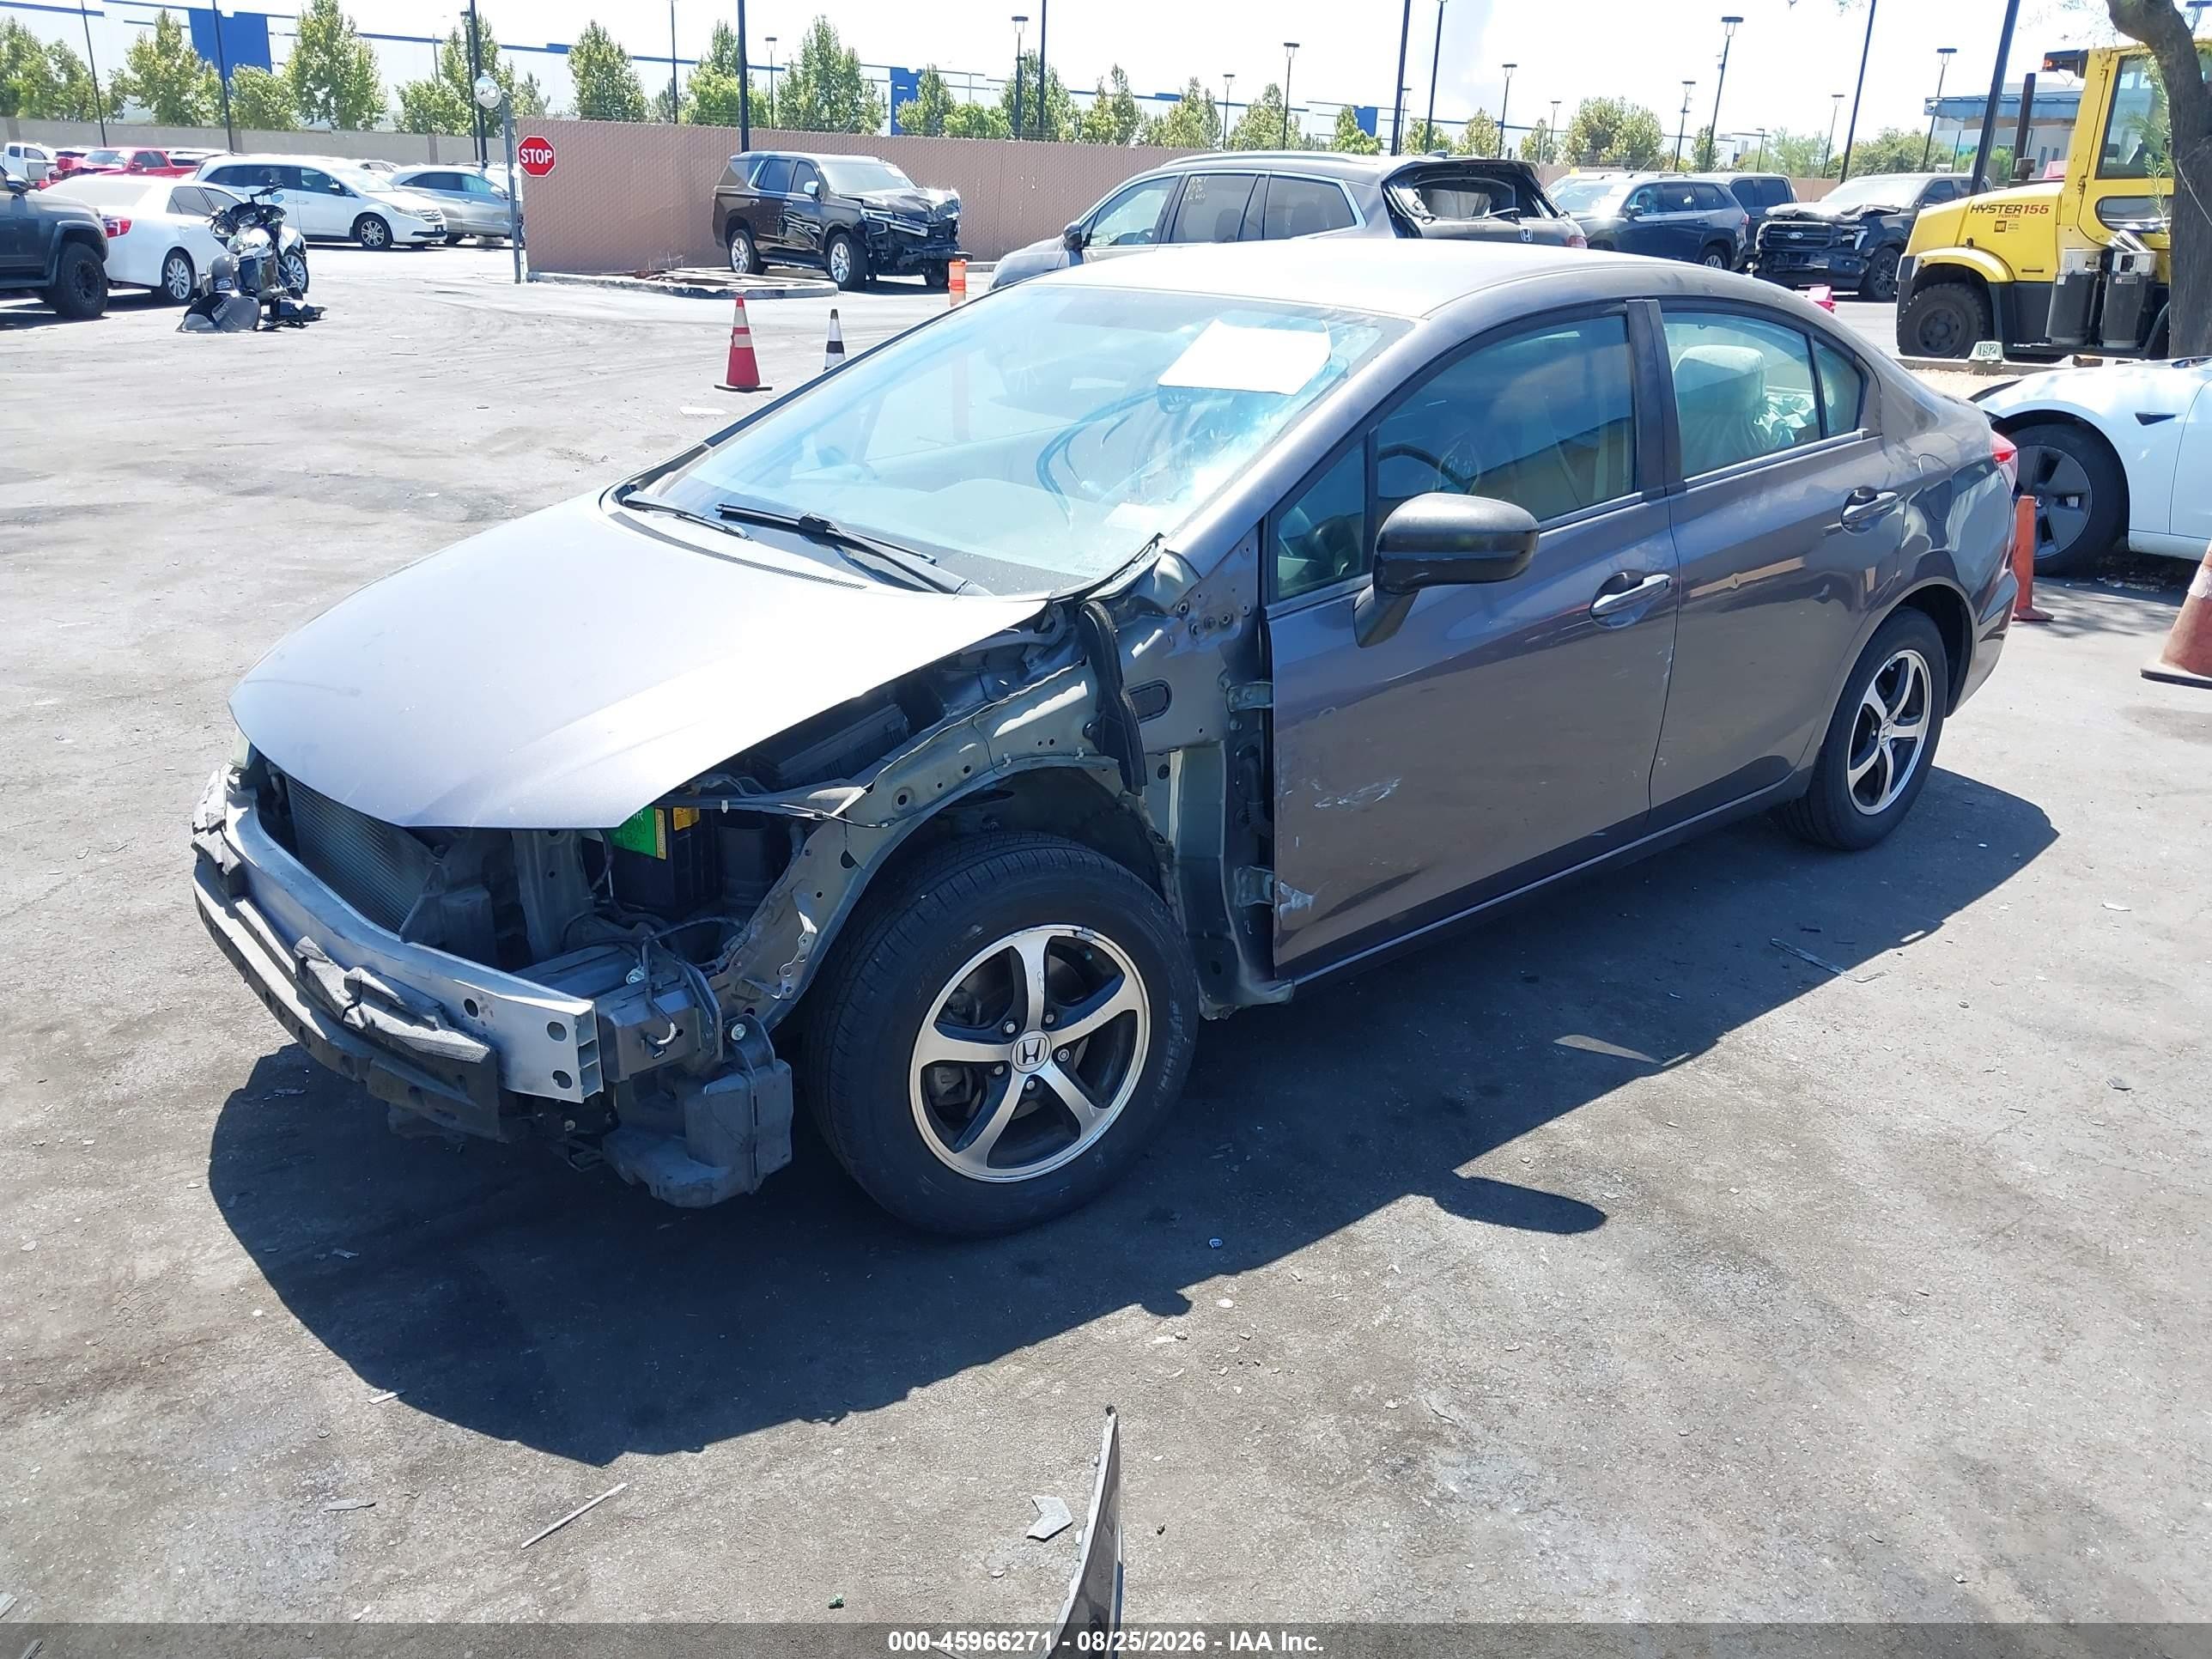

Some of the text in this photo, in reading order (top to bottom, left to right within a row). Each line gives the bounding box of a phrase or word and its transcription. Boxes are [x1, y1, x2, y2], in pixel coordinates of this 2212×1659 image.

[520, 148, 553, 165] STOP
[1970, 204, 2022, 214] HYSTER
[1978, 343, 1997, 356] 192
